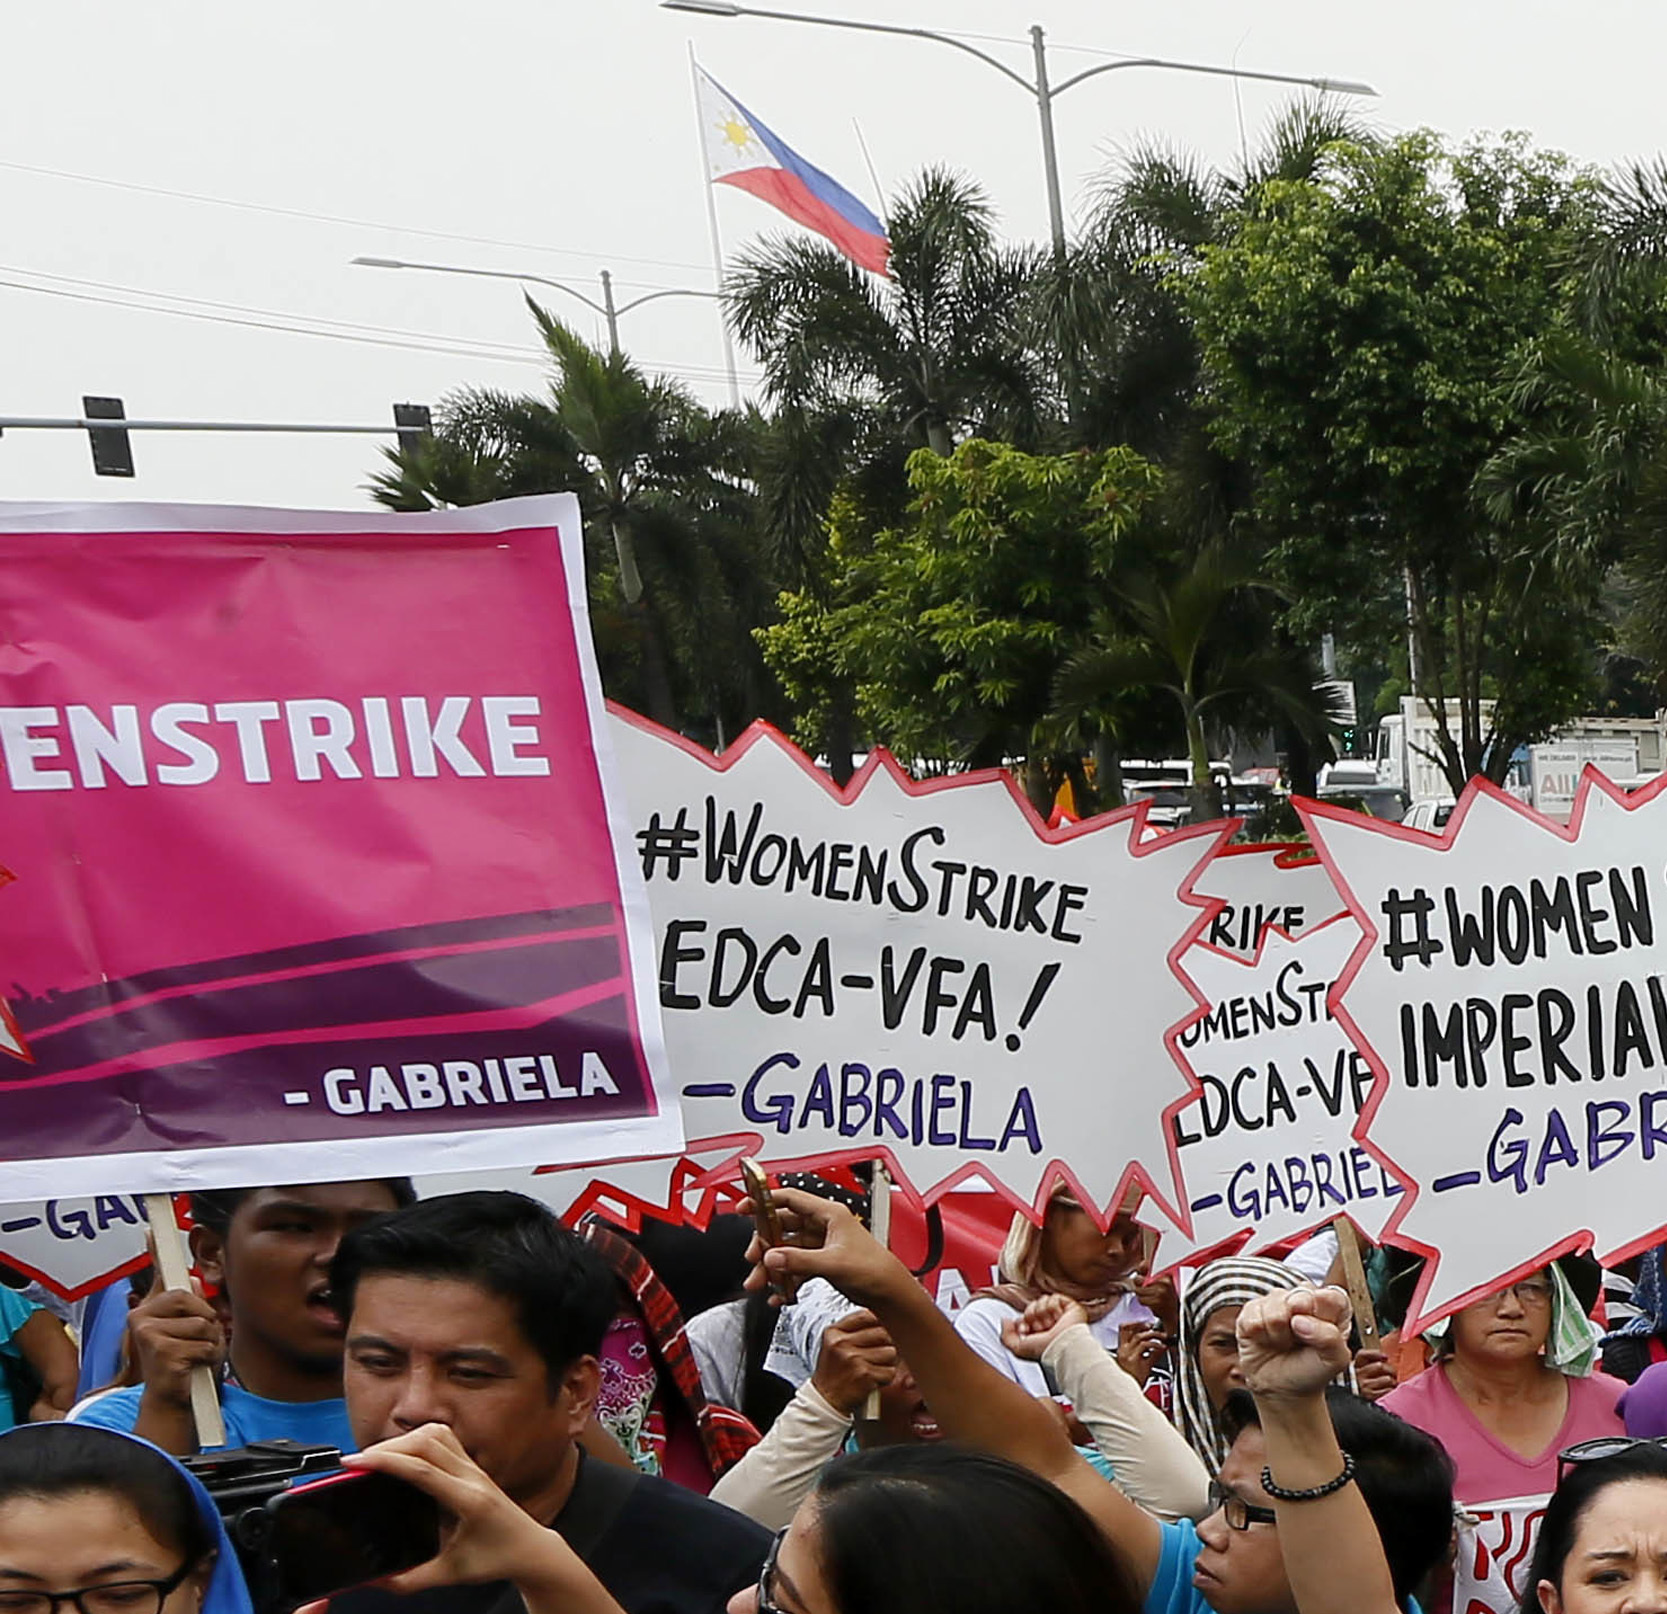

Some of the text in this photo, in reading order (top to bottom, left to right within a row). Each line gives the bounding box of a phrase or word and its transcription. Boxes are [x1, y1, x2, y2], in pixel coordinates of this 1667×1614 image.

[0, 696, 550, 791] ENSTRIKE
[636, 795, 1089, 943] #WOMENSTRIKE
[1380, 864, 1655, 970] #WOMEN
[659, 919, 1062, 1052] EDCA-VFA!
[324, 1050, 621, 1117] GABRIELA
